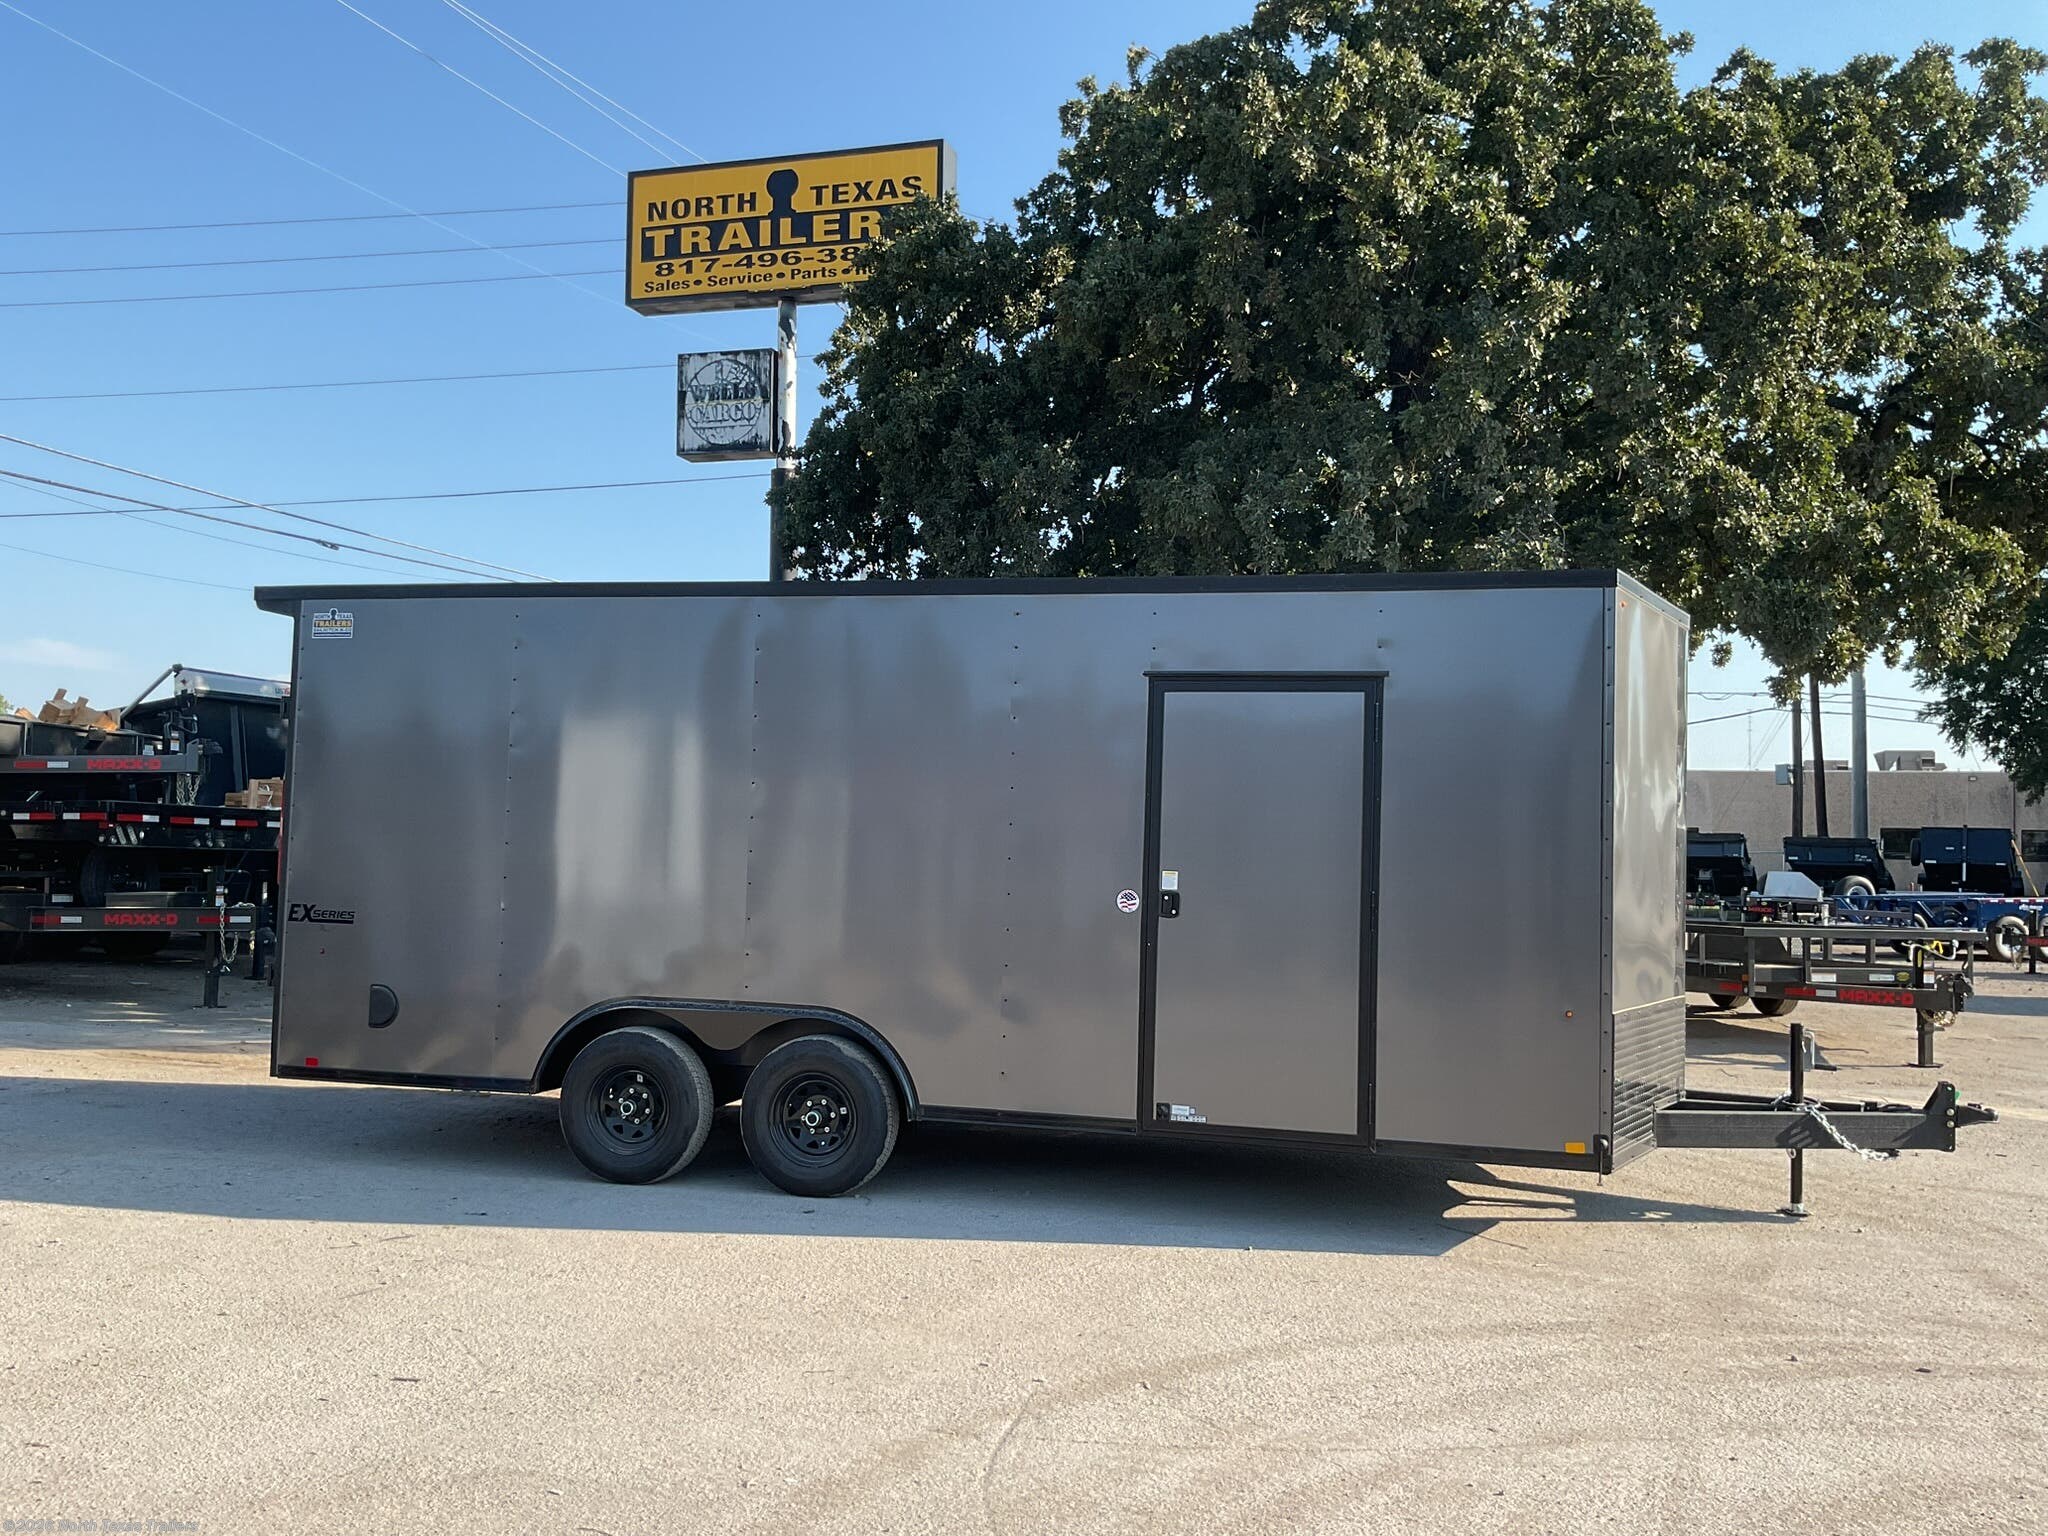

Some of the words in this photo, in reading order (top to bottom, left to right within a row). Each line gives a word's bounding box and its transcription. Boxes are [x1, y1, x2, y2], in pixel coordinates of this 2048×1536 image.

[648, 191, 757, 222] NORTH
[810, 176, 922, 206] TEXAS
[645, 210, 883, 258] TRAILER
[655, 245, 860, 278] 817-496-38
[644, 279, 691, 293] Sales
[707, 272, 773, 287] Service
[790, 266, 838, 281] Parts
[689, 402, 757, 423] CARGO
[104, 913, 178, 926] MAXX-D
[288, 903, 316, 922] EX
[312, 910, 355, 920] SERIES
[1839, 989, 1915, 1006] MAXX-D
